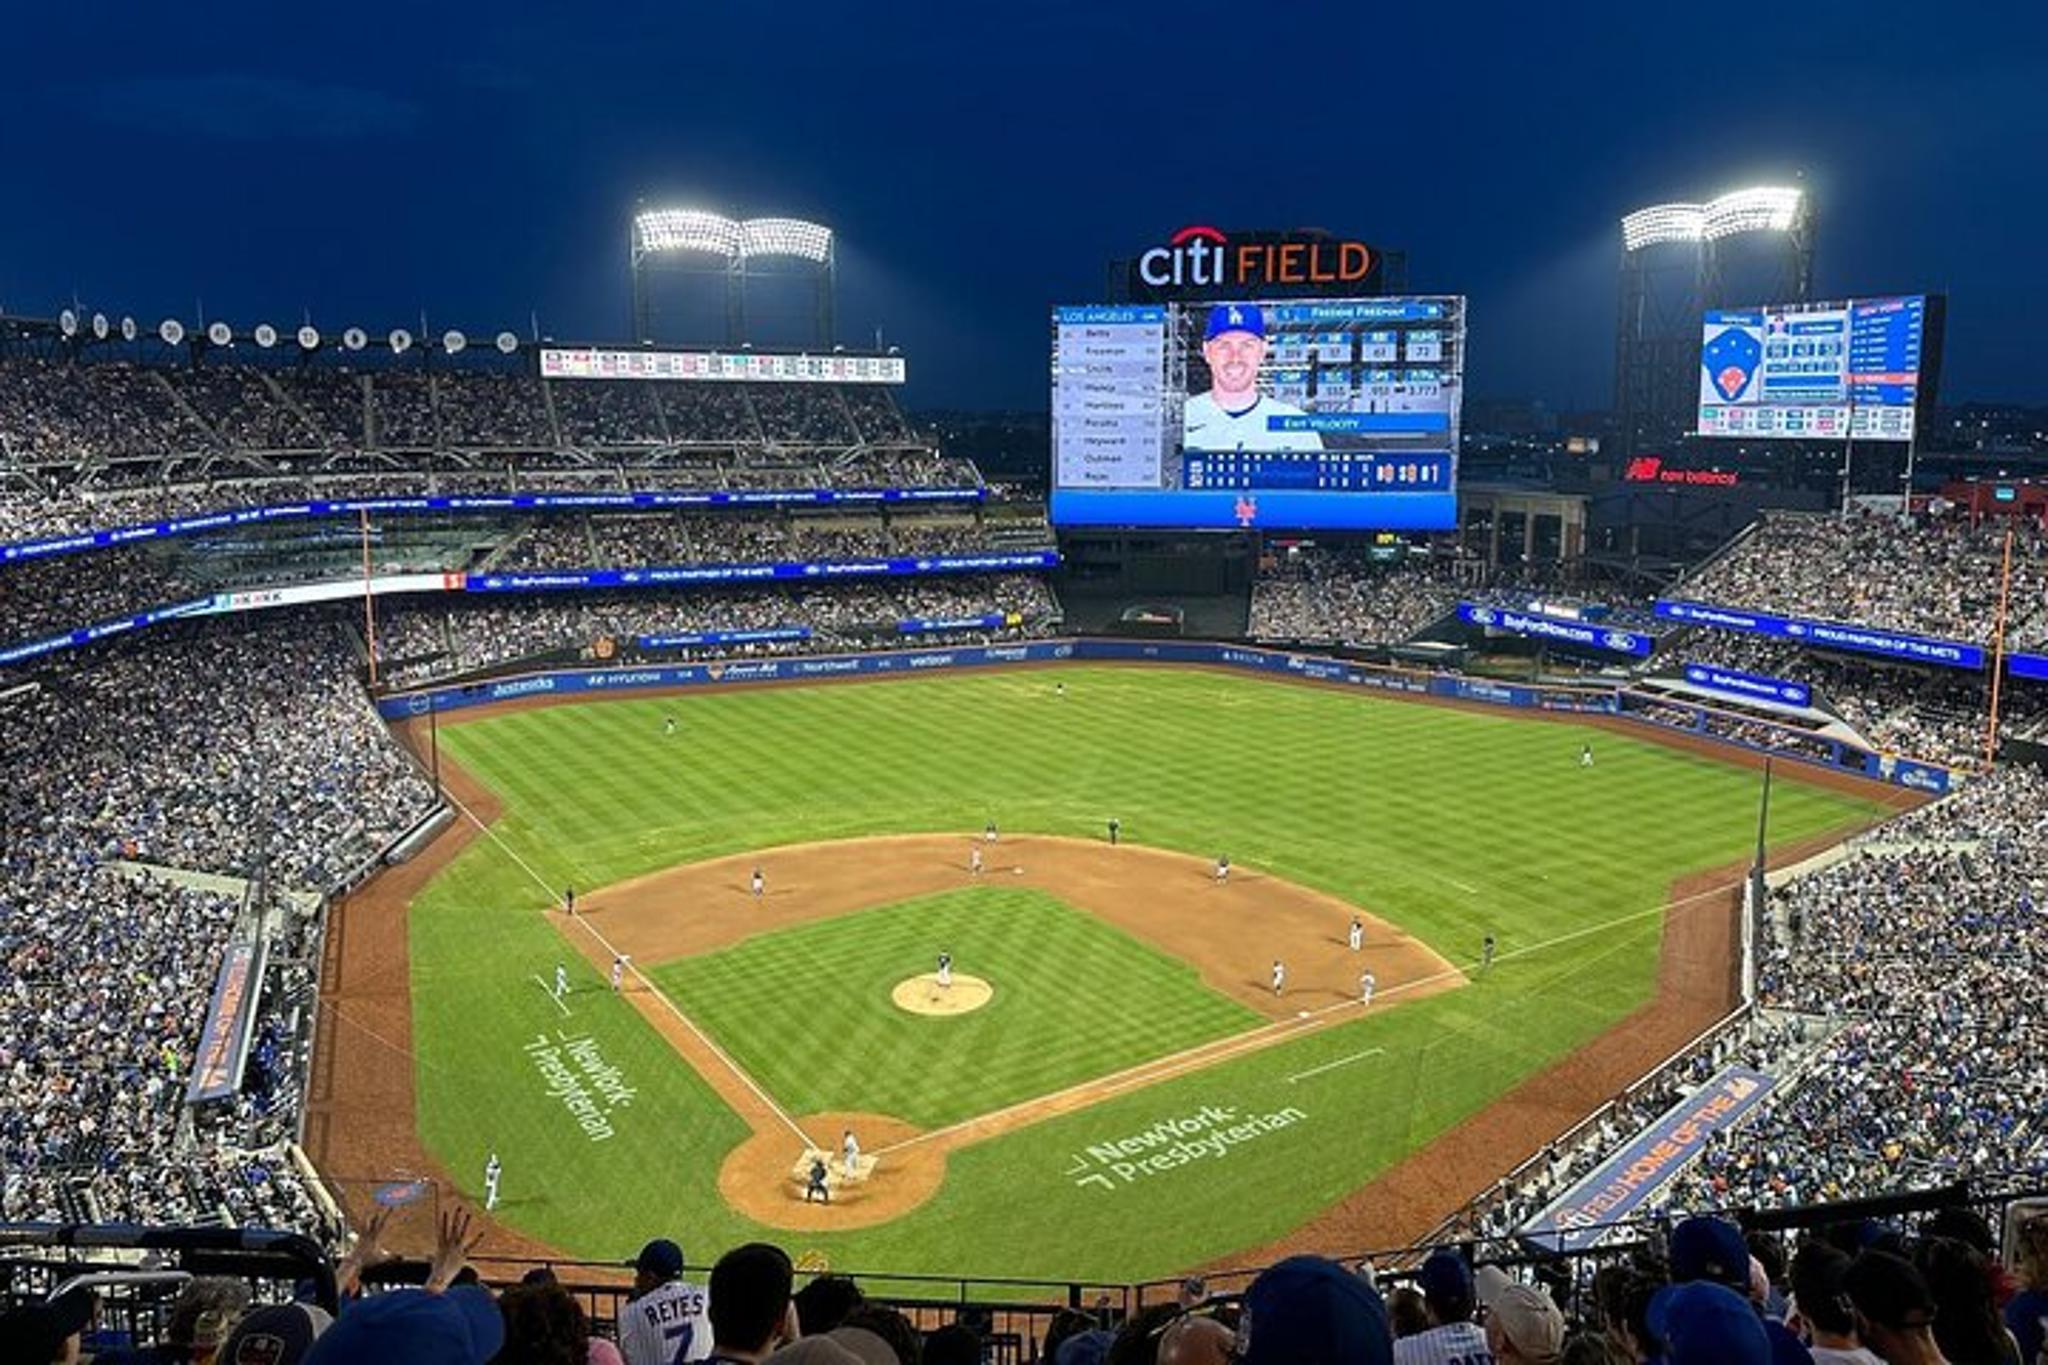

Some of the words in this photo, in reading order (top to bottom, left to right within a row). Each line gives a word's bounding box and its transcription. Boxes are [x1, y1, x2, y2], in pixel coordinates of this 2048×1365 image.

[1140, 238, 1224, 285] citi
[1237, 242, 1370, 283] FIELD
[1063, 311, 1085, 322] LOS
[1087, 310, 1135, 322] ANGELES
[1503, 614, 1594, 643] BuyFordNow.com
[1109, 1106, 1309, 1183] Presbyterian
[1621, 1140, 1684, 1191] HOME
[644, 1293, 704, 1328] REYES
[664, 1322, 694, 1365] 7
